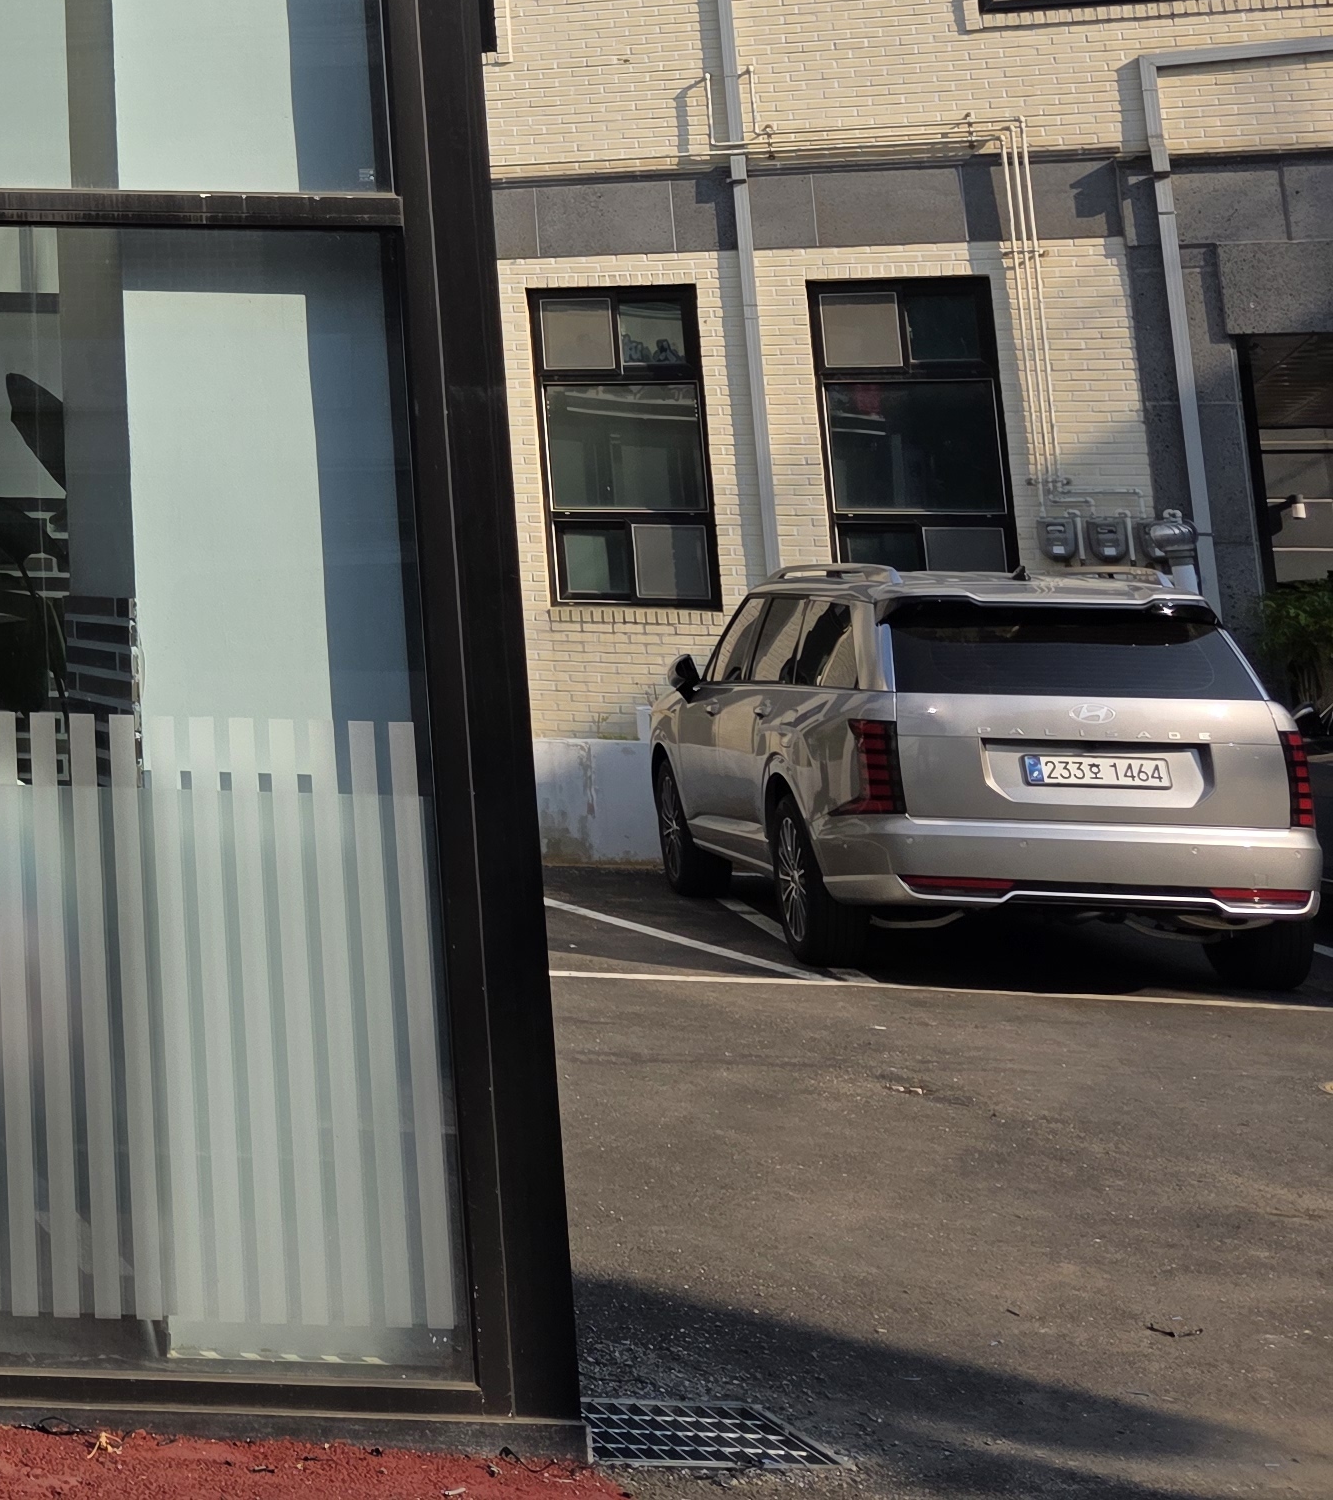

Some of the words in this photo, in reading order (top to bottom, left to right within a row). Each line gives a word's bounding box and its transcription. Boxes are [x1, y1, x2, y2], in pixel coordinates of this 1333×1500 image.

[976, 726, 1212, 741] PALISADE
[1044, 760, 1104, 780] 233호
[1109, 762, 1164, 783] 1464
